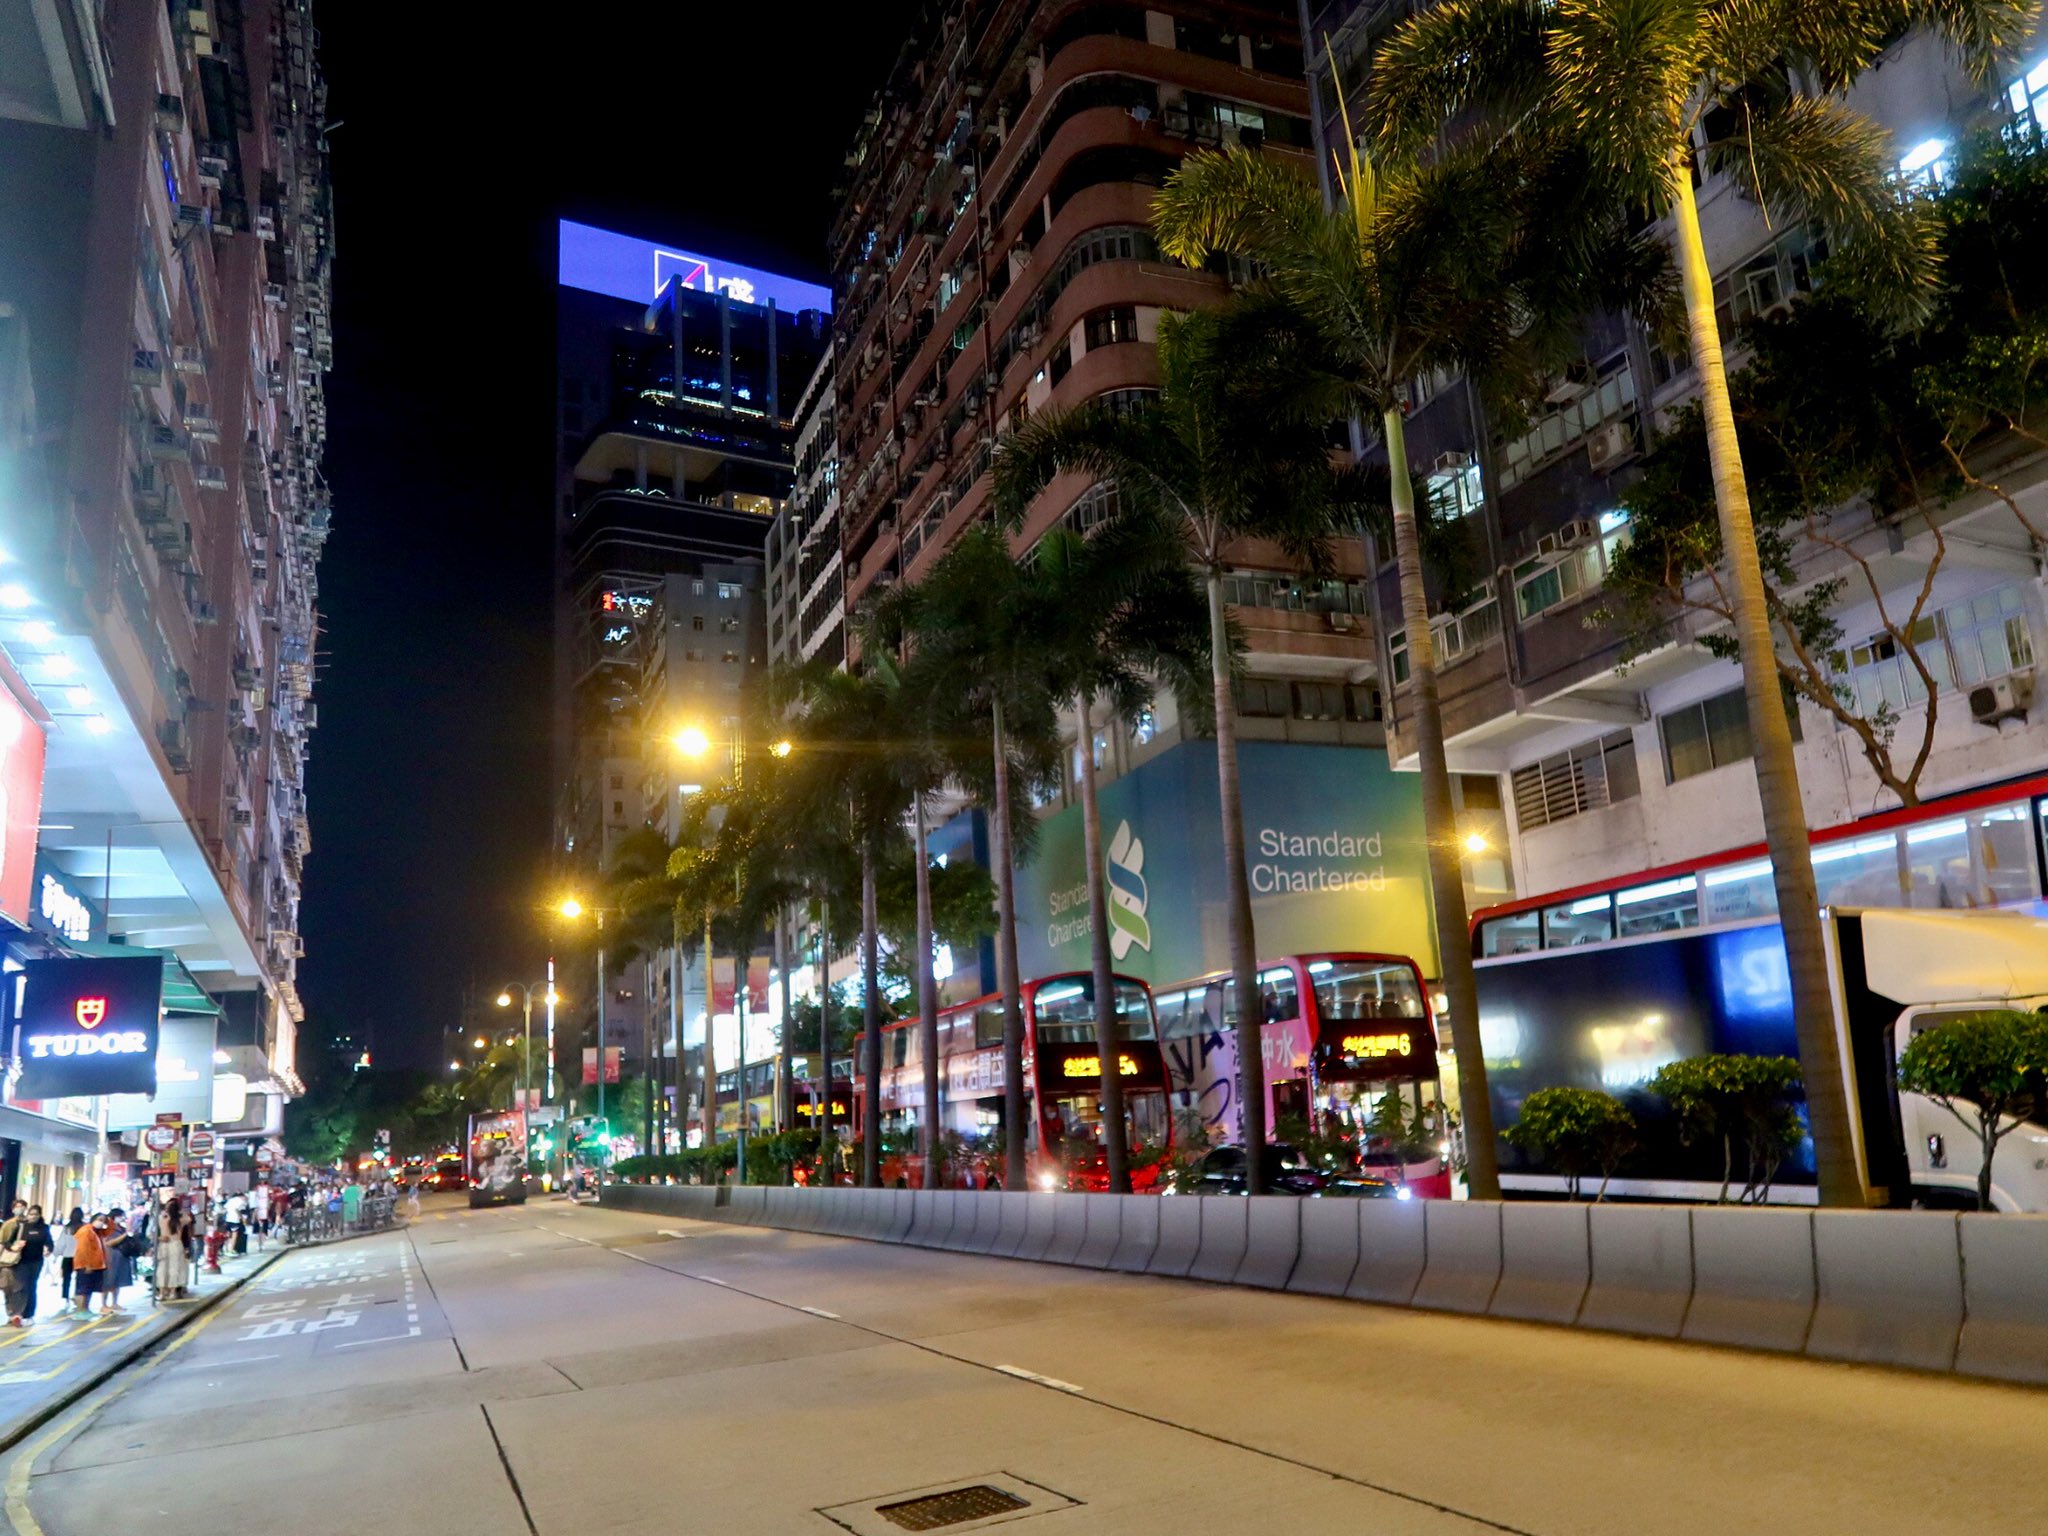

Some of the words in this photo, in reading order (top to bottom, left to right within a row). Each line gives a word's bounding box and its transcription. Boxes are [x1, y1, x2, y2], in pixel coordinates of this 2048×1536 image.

[1259, 828, 1382, 857] Standard
[1251, 863, 1386, 893] Chartered
[1049, 880, 1090, 917] Standa
[1047, 914, 1093, 948] Chartere
[28, 1031, 148, 1058] TUDOR
[1399, 1033, 1411, 1056] 6
[147, 1173, 170, 1188] N4
[191, 1168, 209, 1179] N5
